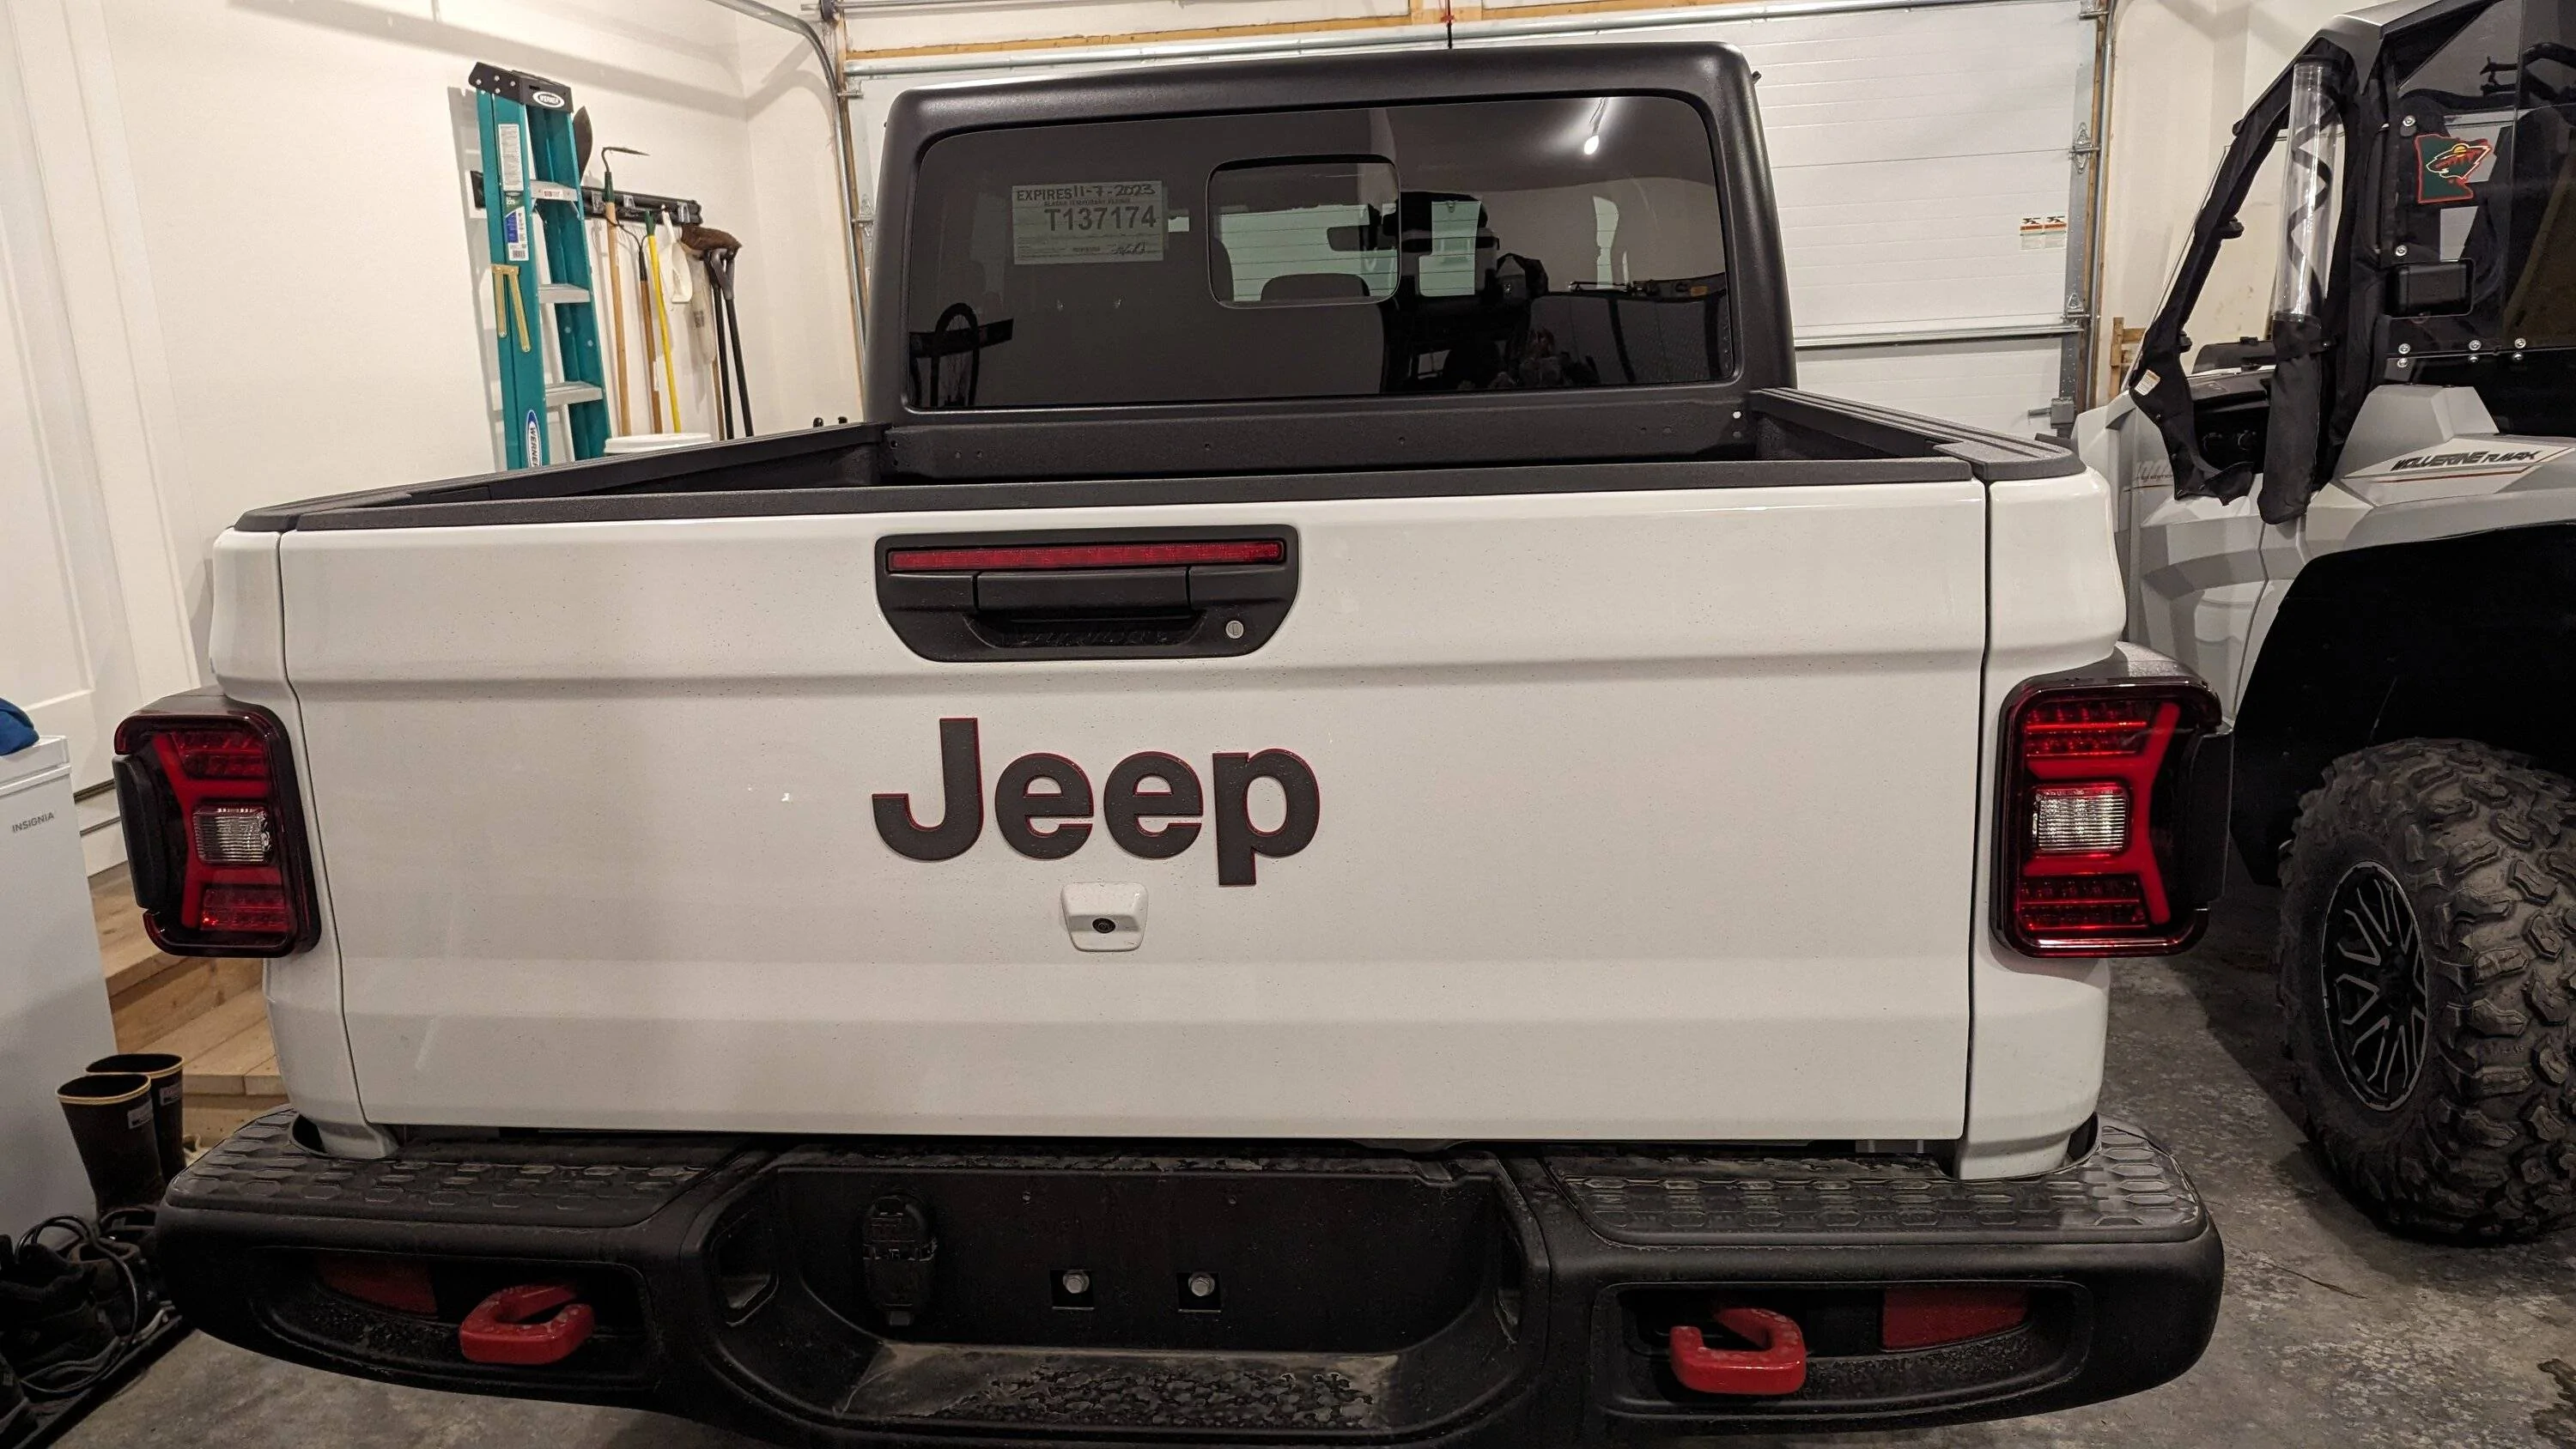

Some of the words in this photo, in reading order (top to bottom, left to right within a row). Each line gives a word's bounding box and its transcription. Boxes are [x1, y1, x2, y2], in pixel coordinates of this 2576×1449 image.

[1017, 188, 1072, 201] EXPIRES
[1044, 205, 1157, 232] T137174
[2391, 451, 2489, 471] WOLVERINE
[872, 717, 1321, 888] Jeep
[12, 811, 54, 833] INSIGNIA
